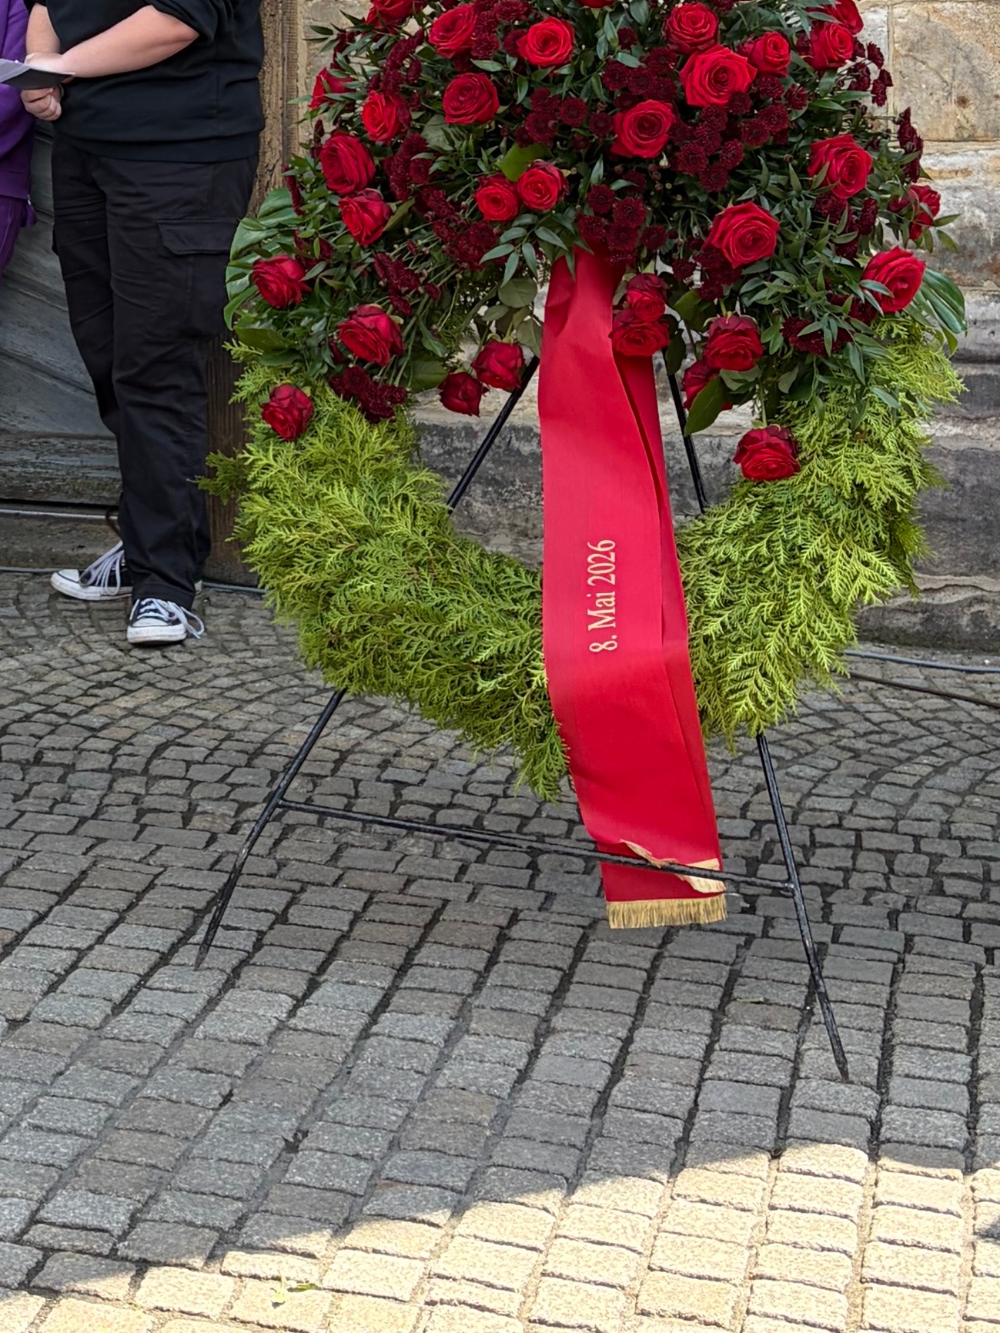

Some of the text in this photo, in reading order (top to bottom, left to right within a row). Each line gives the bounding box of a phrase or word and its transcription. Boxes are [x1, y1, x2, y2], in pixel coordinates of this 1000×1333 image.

[586, 539, 618, 653] 8. Mai 2026
